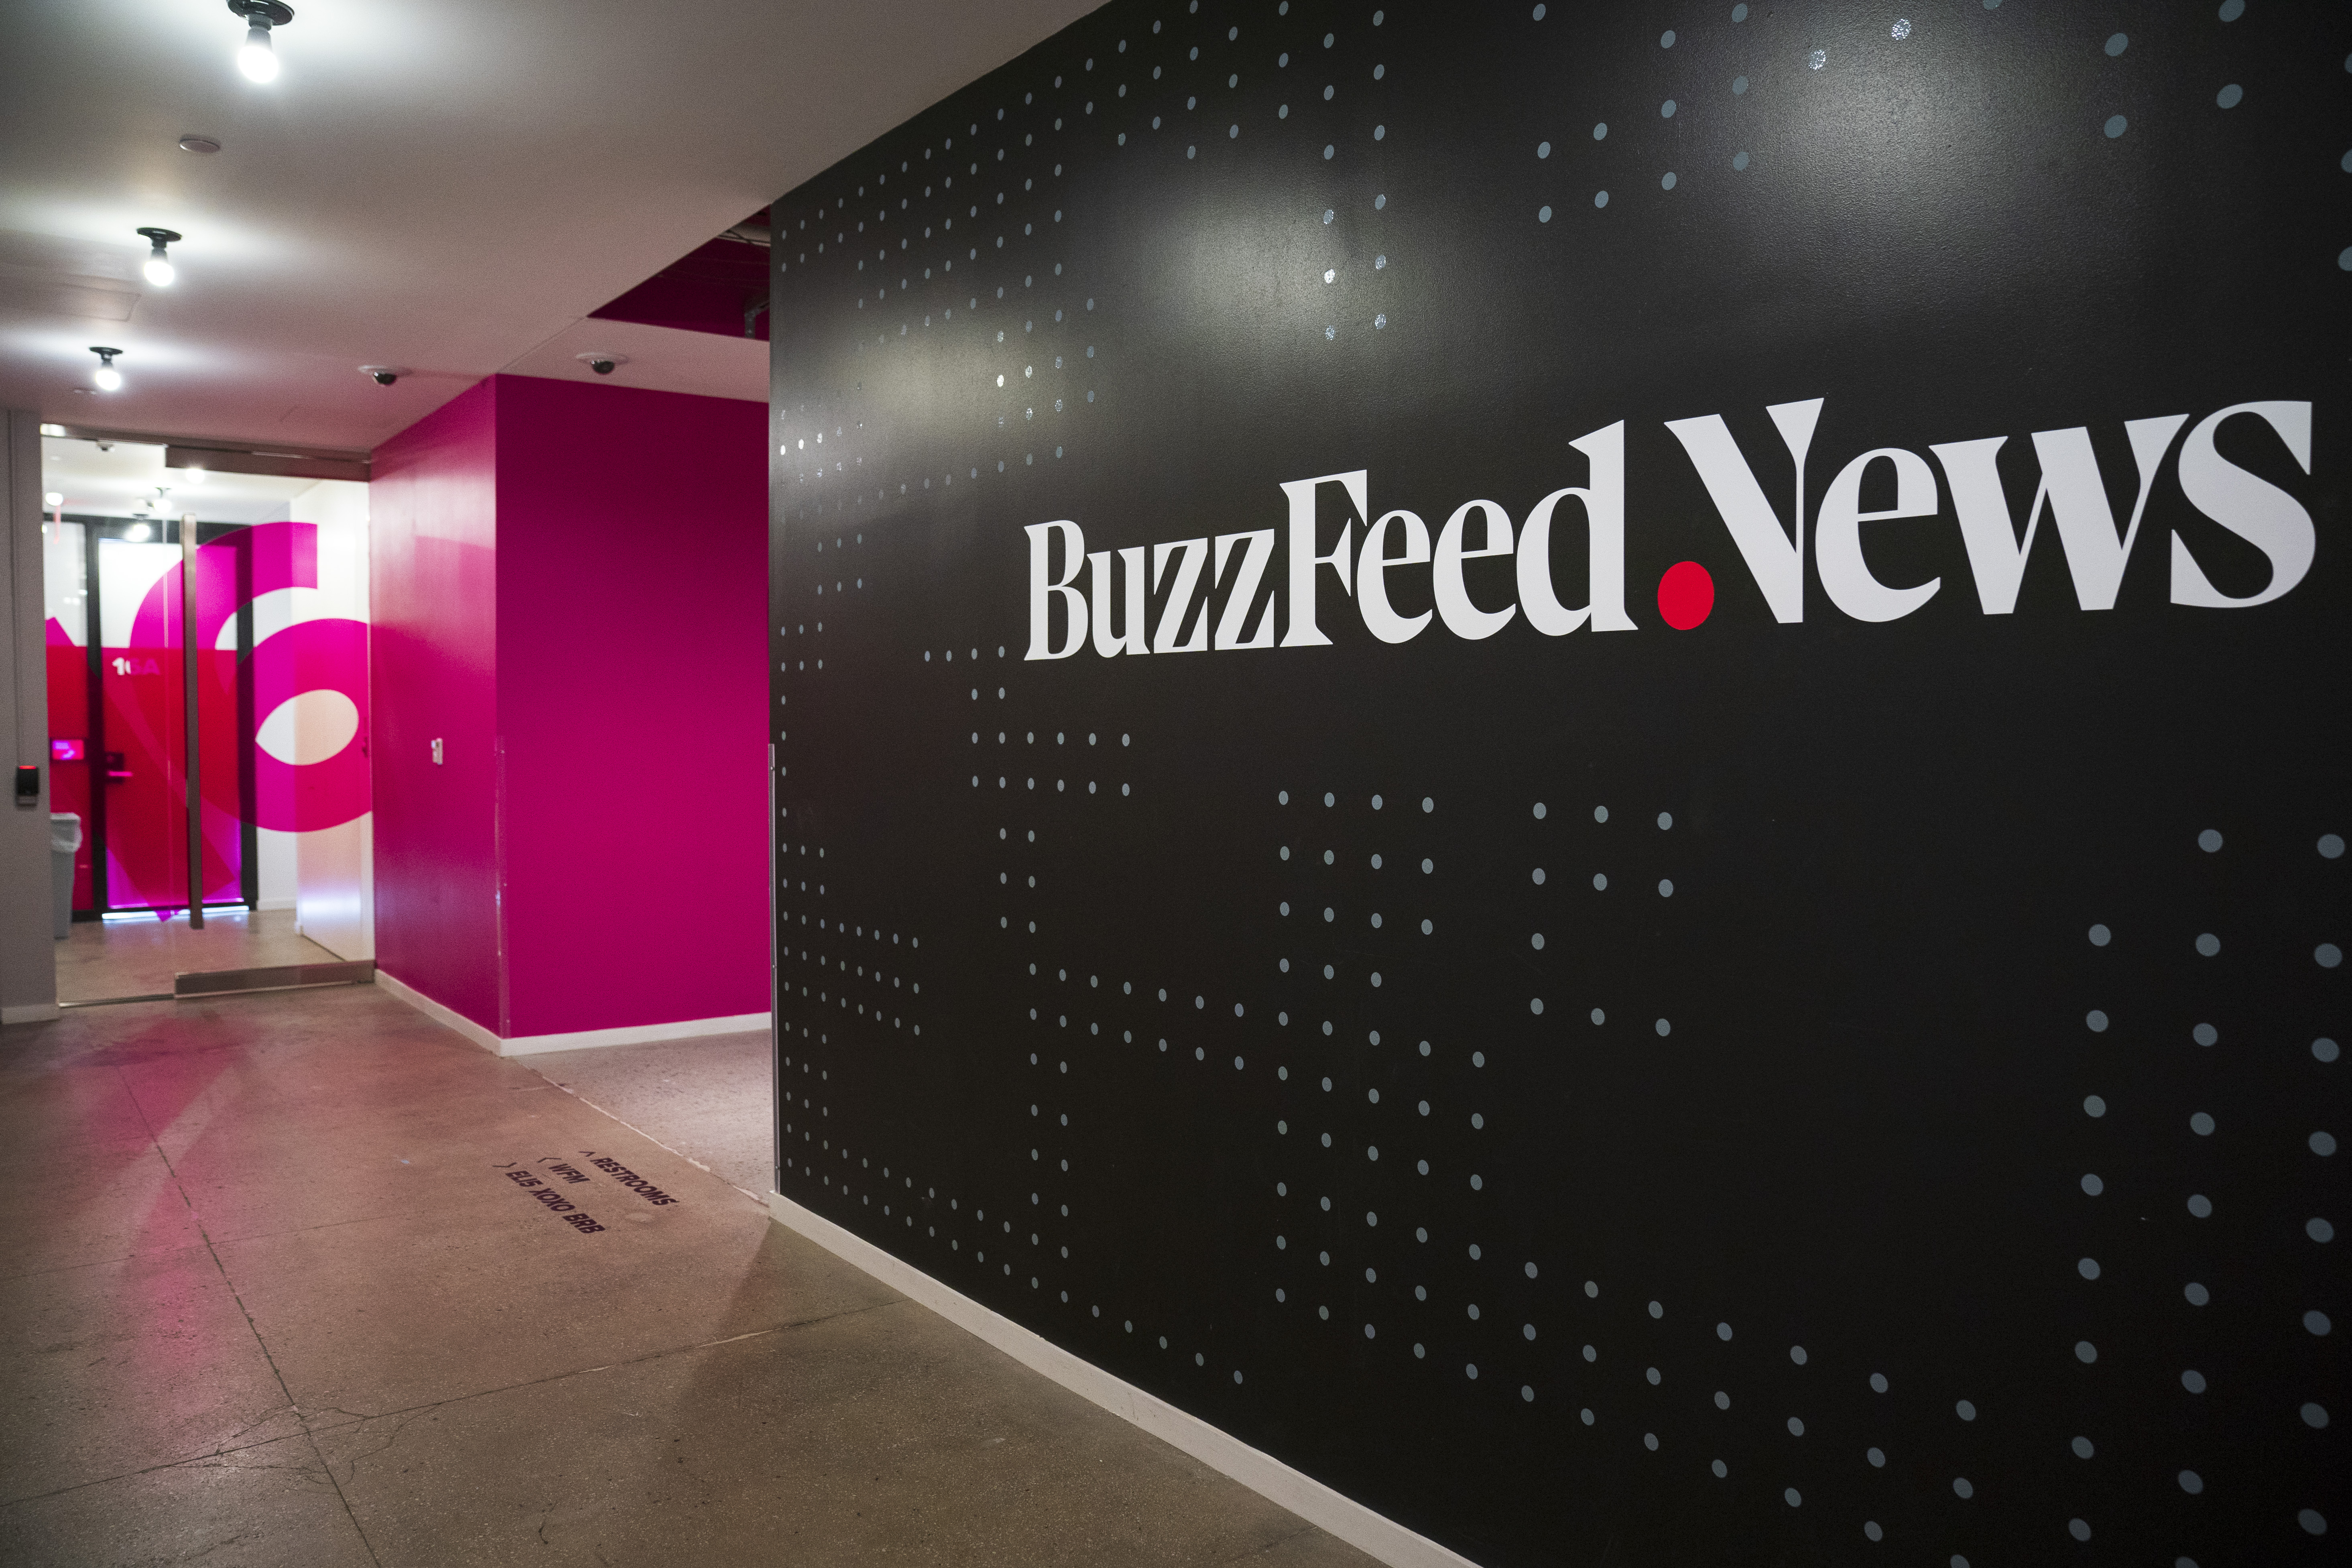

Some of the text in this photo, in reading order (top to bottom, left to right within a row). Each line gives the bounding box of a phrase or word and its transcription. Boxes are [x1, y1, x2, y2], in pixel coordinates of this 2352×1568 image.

[112, 657, 160, 675] 16A
[548, 1163, 590, 1184] WFM
[591, 1157, 679, 1206] RESTROOMS
[529, 1188, 575, 1212] XOXO
[562, 1212, 606, 1234] BRB
